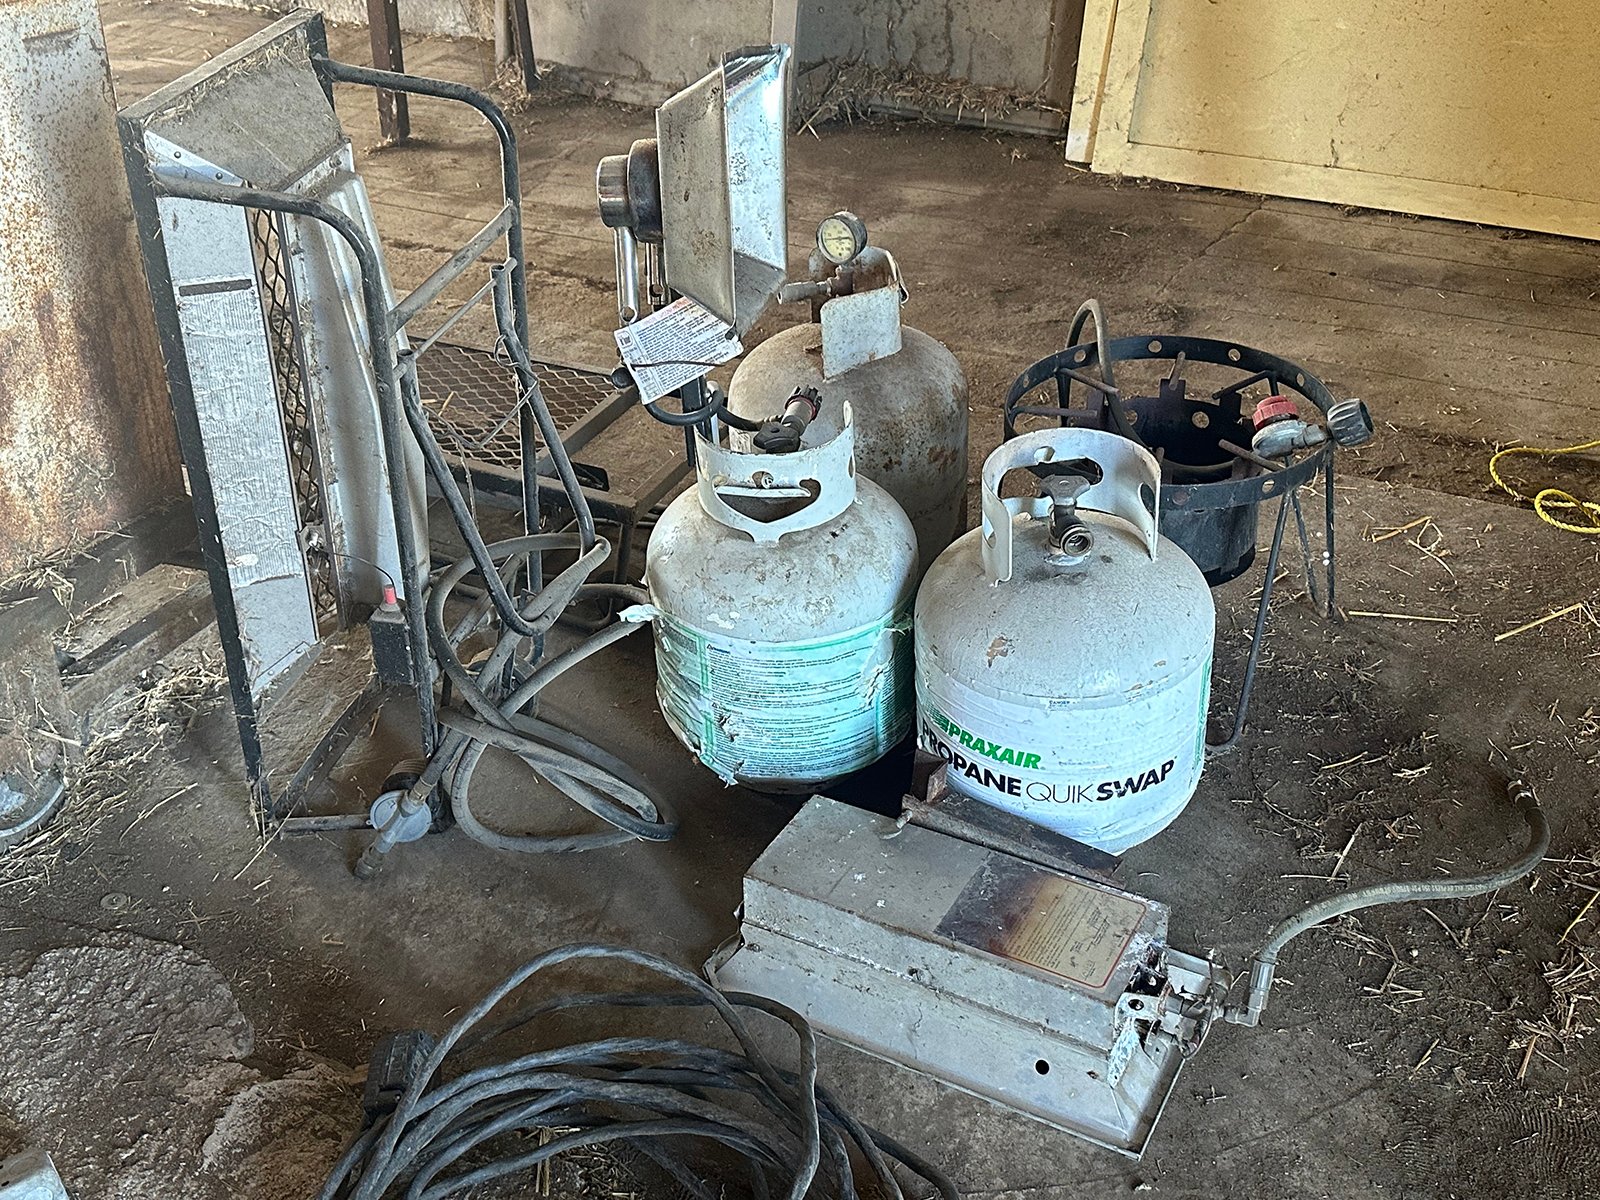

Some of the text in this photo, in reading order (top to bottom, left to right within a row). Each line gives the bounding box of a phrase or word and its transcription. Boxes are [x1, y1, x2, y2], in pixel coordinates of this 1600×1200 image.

[922, 718, 1022, 797] PROPANE
[1026, 782, 1094, 803] QUIK
[1096, 758, 1175, 801] SWAP
[946, 721, 1042, 769] PRAXAIR
